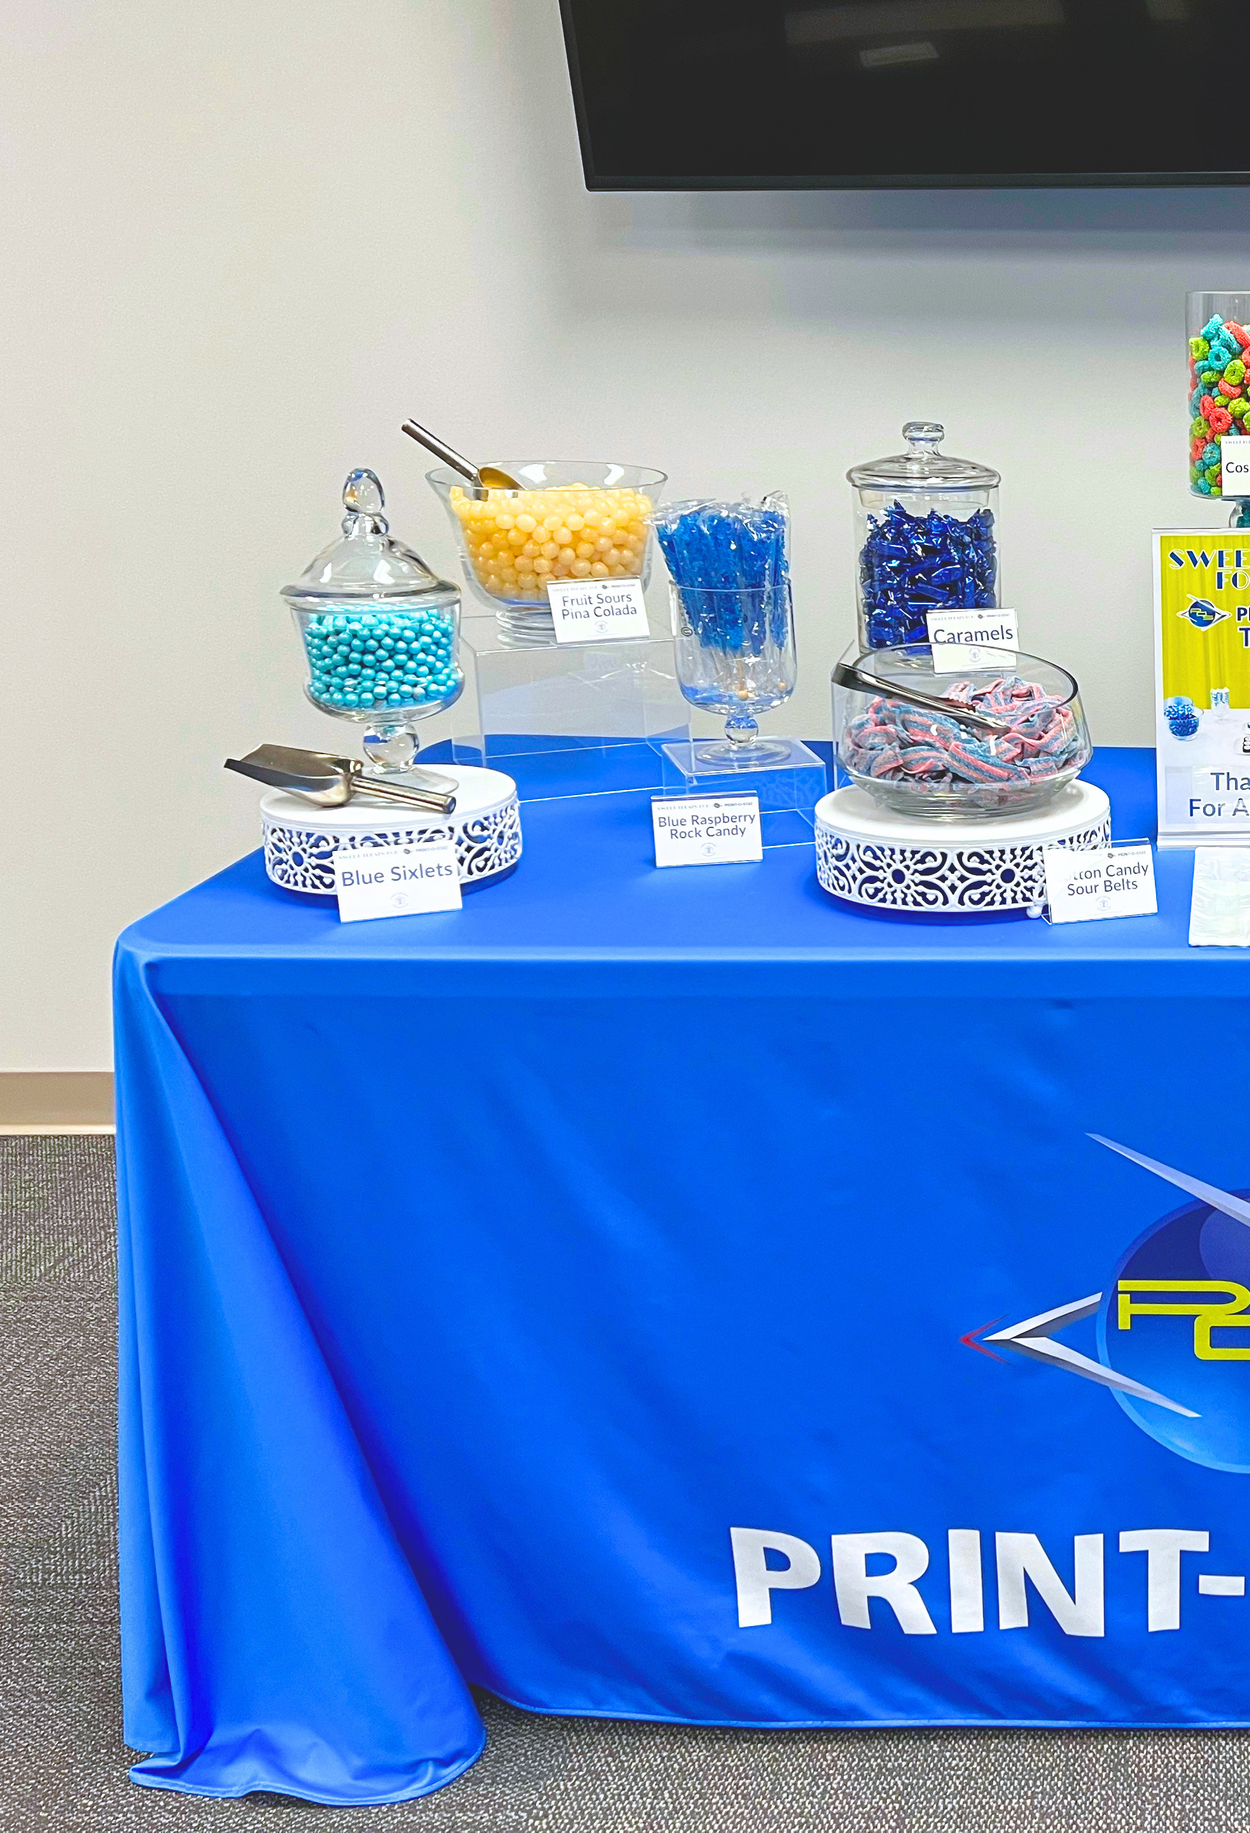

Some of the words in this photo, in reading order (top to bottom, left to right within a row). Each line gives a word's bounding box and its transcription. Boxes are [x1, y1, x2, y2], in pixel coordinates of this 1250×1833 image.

[562, 594, 593, 606] Fruit
[596, 593, 632, 604] Sours
[562, 608, 590, 620] Pina
[594, 604, 637, 618] Colada
[934, 624, 1014, 644] Caramels
[1189, 798, 1225, 817] For
[658, 816, 687, 828] Blue
[691, 813, 756, 826] Raspberry
[670, 827, 702, 840] Rock
[706, 825, 746, 838] Candy
[342, 870, 384, 886] Blue
[390, 863, 453, 882] Sixlets
[1064, 868, 1102, 880] otton
[1106, 862, 1149, 877] Candy
[1067, 883, 1100, 896] Sour
[1104, 878, 1138, 892] Belts
